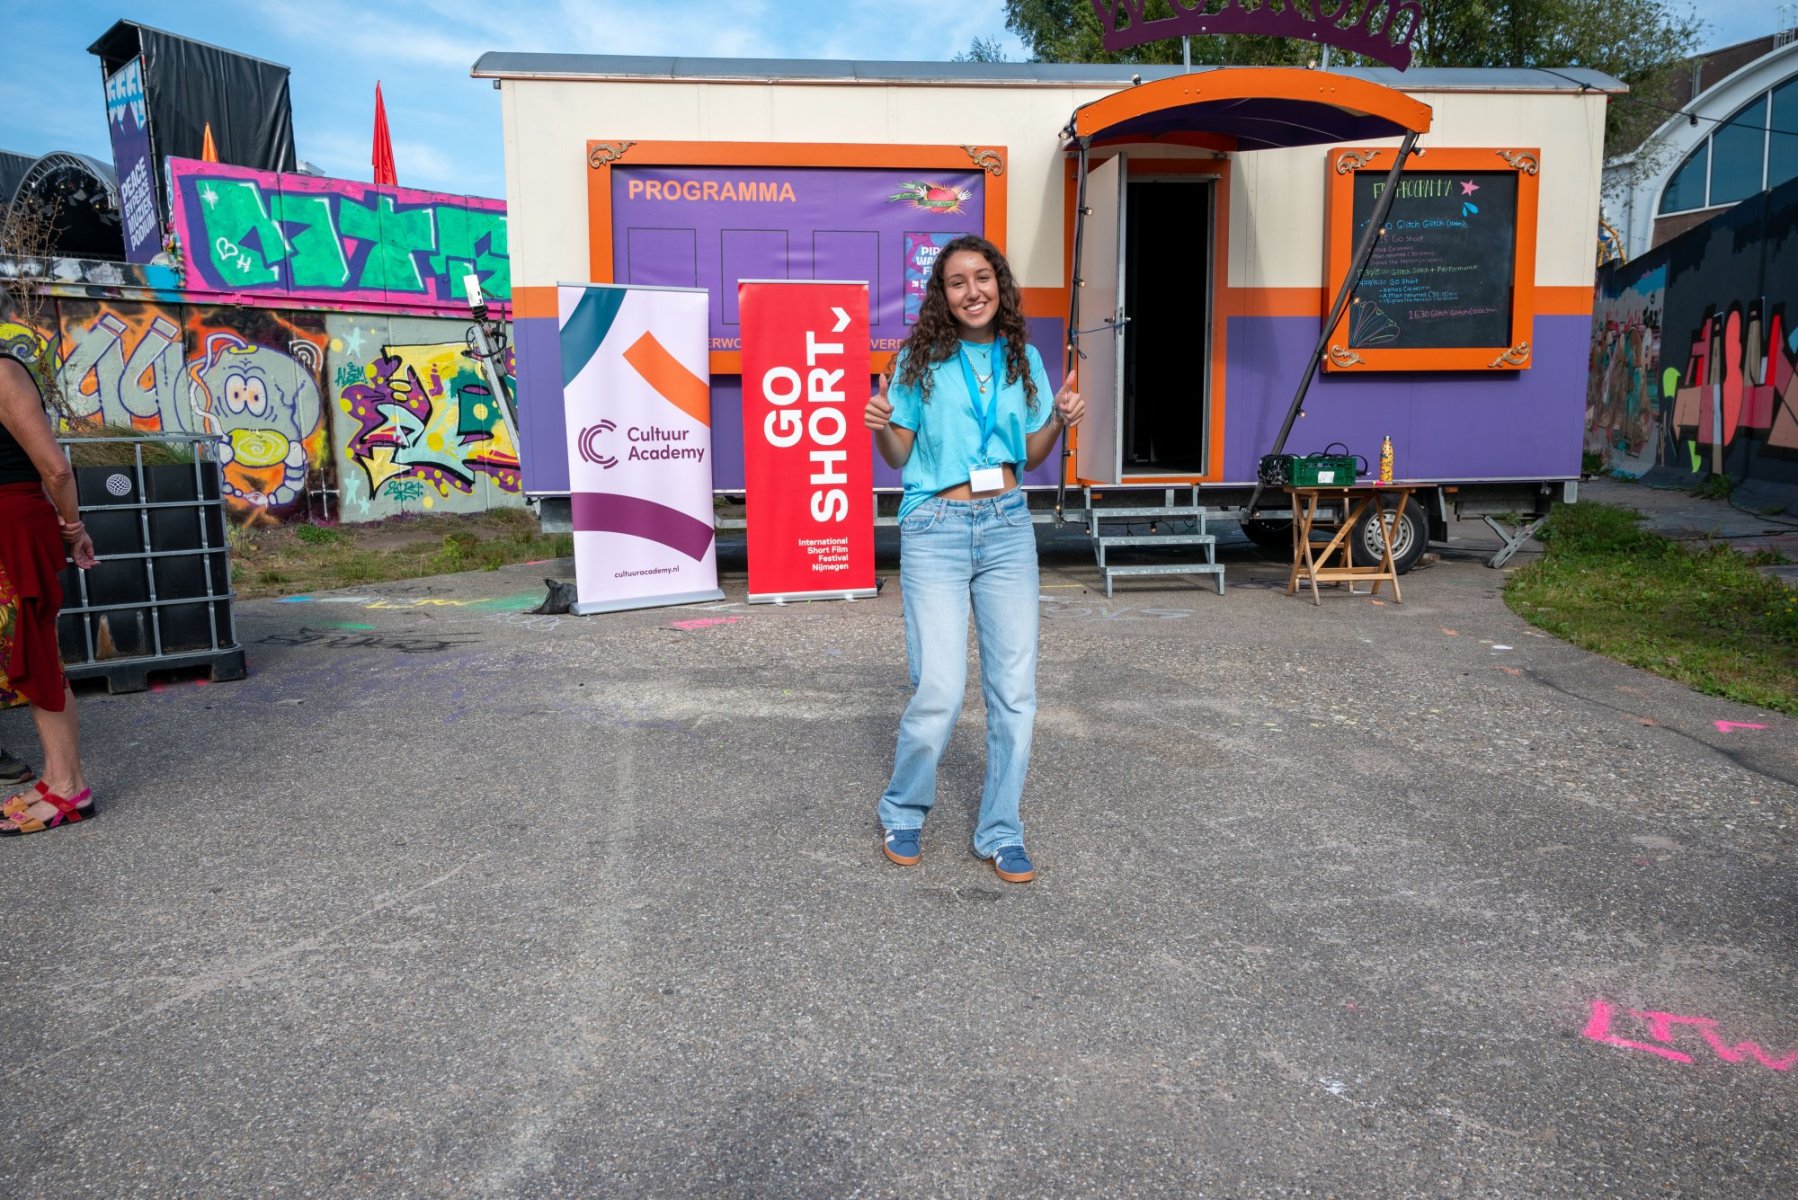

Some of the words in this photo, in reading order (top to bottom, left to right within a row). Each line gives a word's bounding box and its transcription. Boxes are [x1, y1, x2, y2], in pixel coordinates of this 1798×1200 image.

[121, 155, 148, 205] PEACE
[628, 179, 796, 202] PROGRAMMA
[127, 192, 154, 236] MUZIEK
[130, 209, 157, 252] PODIUM
[921, 247, 943, 256] PIP
[916, 256, 936, 266] WA
[763, 366, 803, 448] GO
[627, 426, 690, 442] Cultuur
[806, 331, 849, 523] SHORT
[628, 444, 705, 463] Academy
[798, 537, 848, 546] International
[807, 546, 830, 555] Short
[831, 545, 848, 553] Film
[818, 554, 848, 562] Festival
[614, 565, 680, 578] cultuuracademy.nl
[812, 563, 849, 572] Nijmegen
